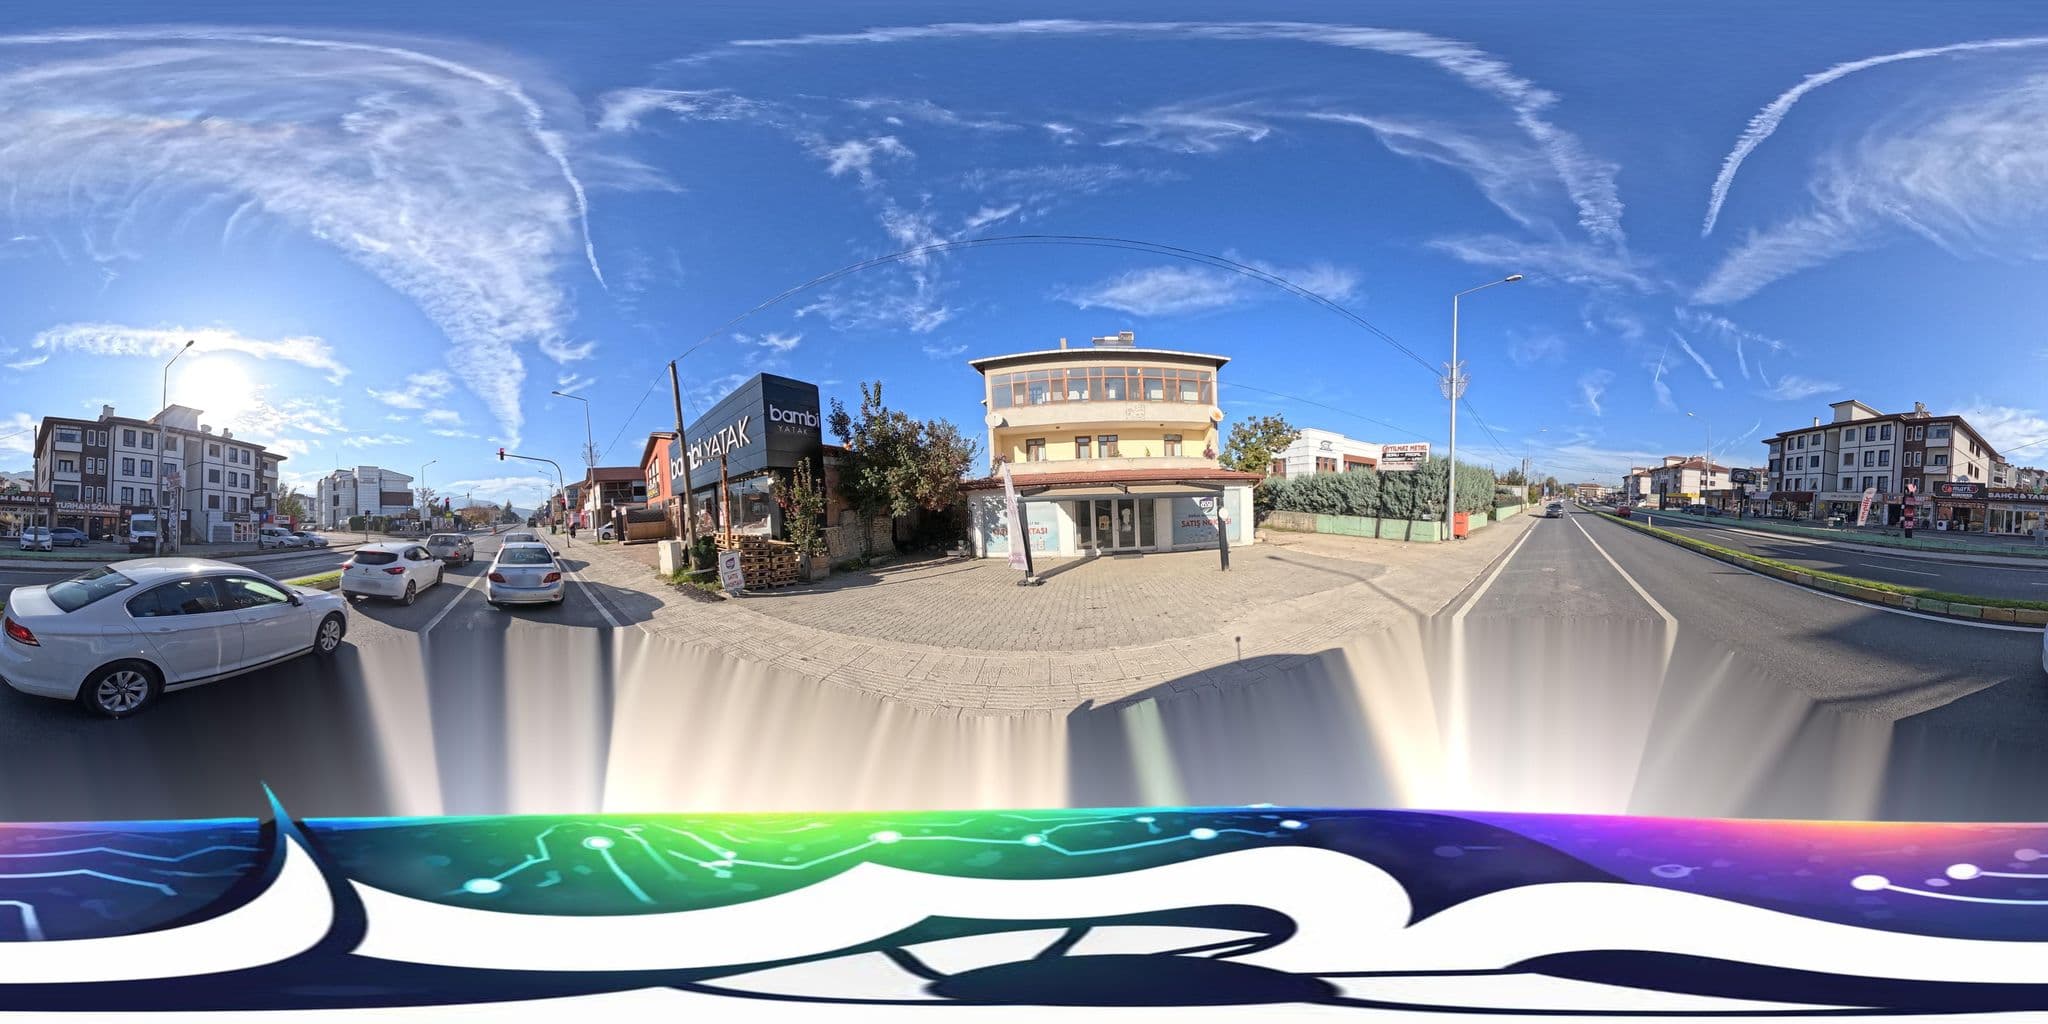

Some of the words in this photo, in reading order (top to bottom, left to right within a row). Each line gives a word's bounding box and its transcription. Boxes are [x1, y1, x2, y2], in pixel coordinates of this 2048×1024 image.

[769, 404, 820, 429] bambi
[777, 424, 808, 436] YATAK
[704, 416, 751, 462] YATAK
[11, 495, 51, 503] MARET
[55, 501, 90, 510] TURHAN
